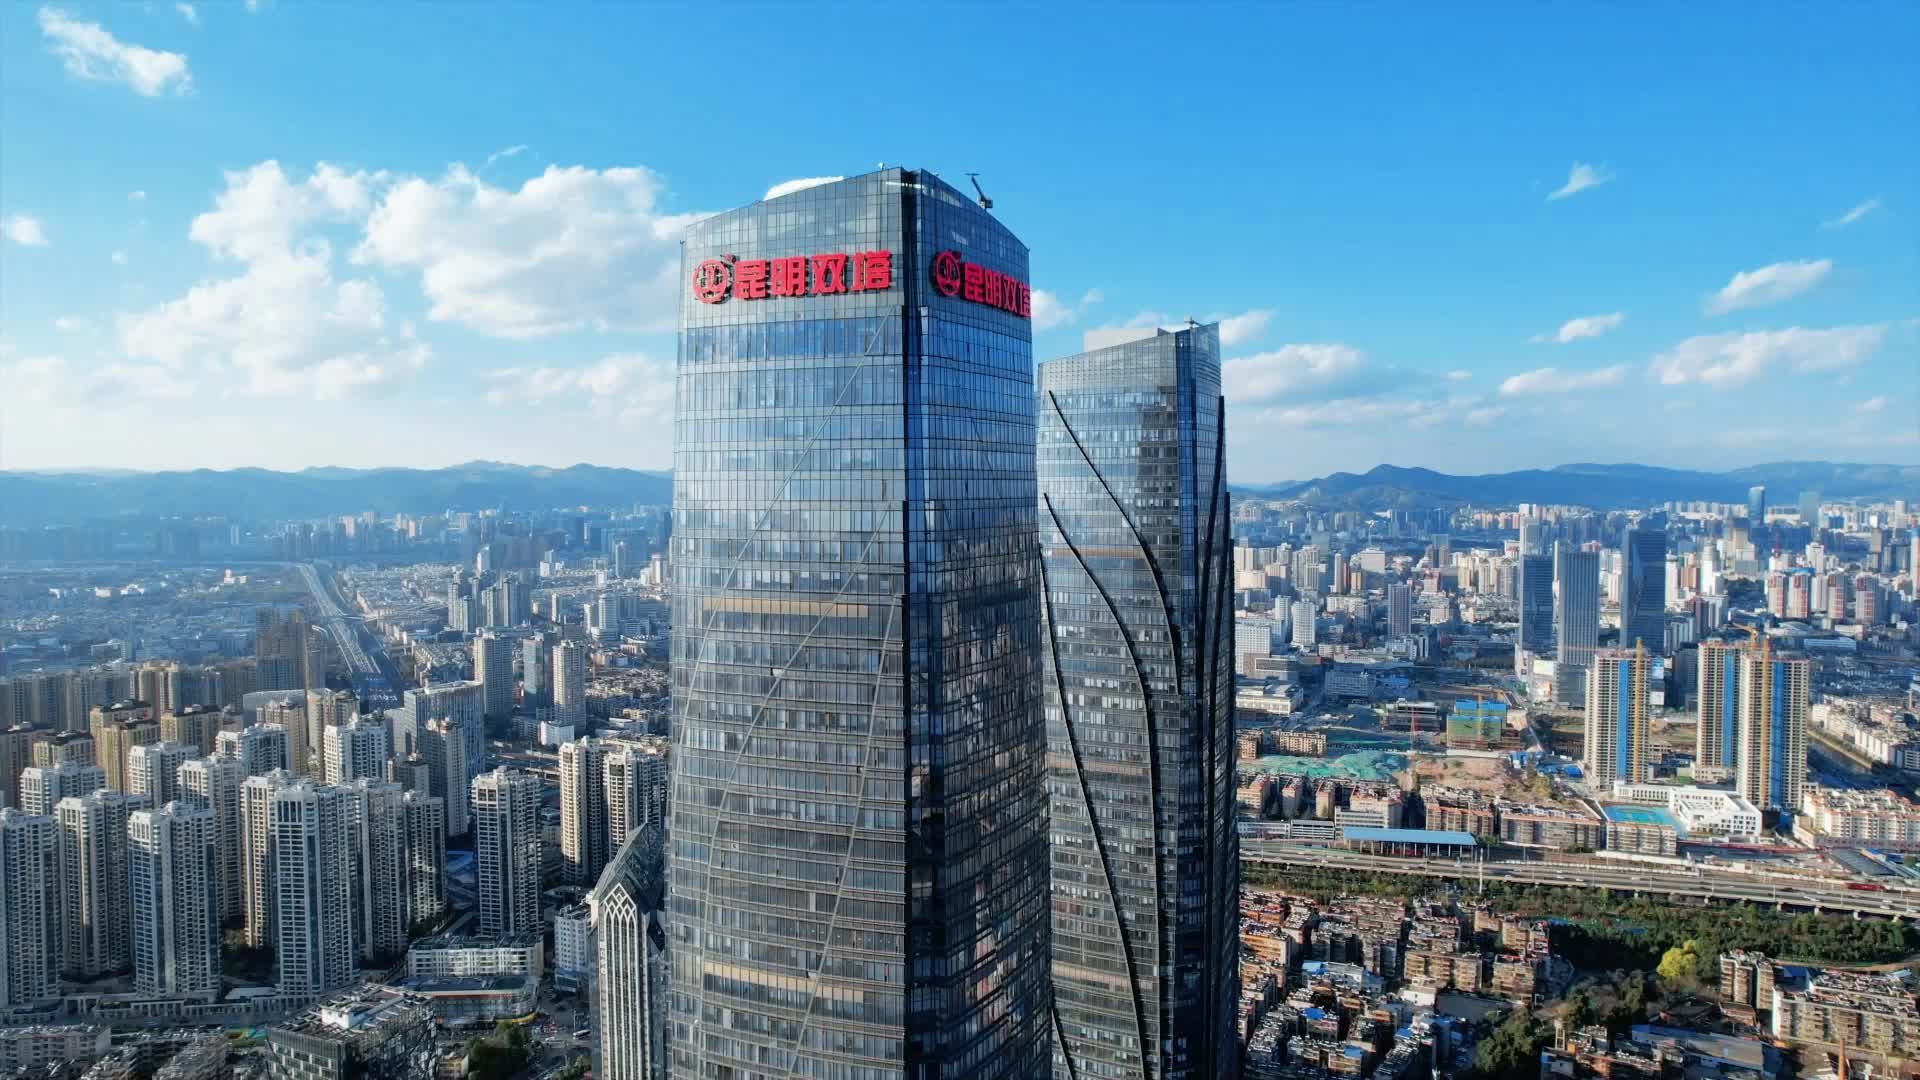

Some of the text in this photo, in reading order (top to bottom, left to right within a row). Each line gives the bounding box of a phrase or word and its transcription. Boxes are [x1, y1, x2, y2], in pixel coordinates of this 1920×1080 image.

[734, 250, 890, 299] 昆明双塔
[965, 262, 1031, 317] 昆明双塔
